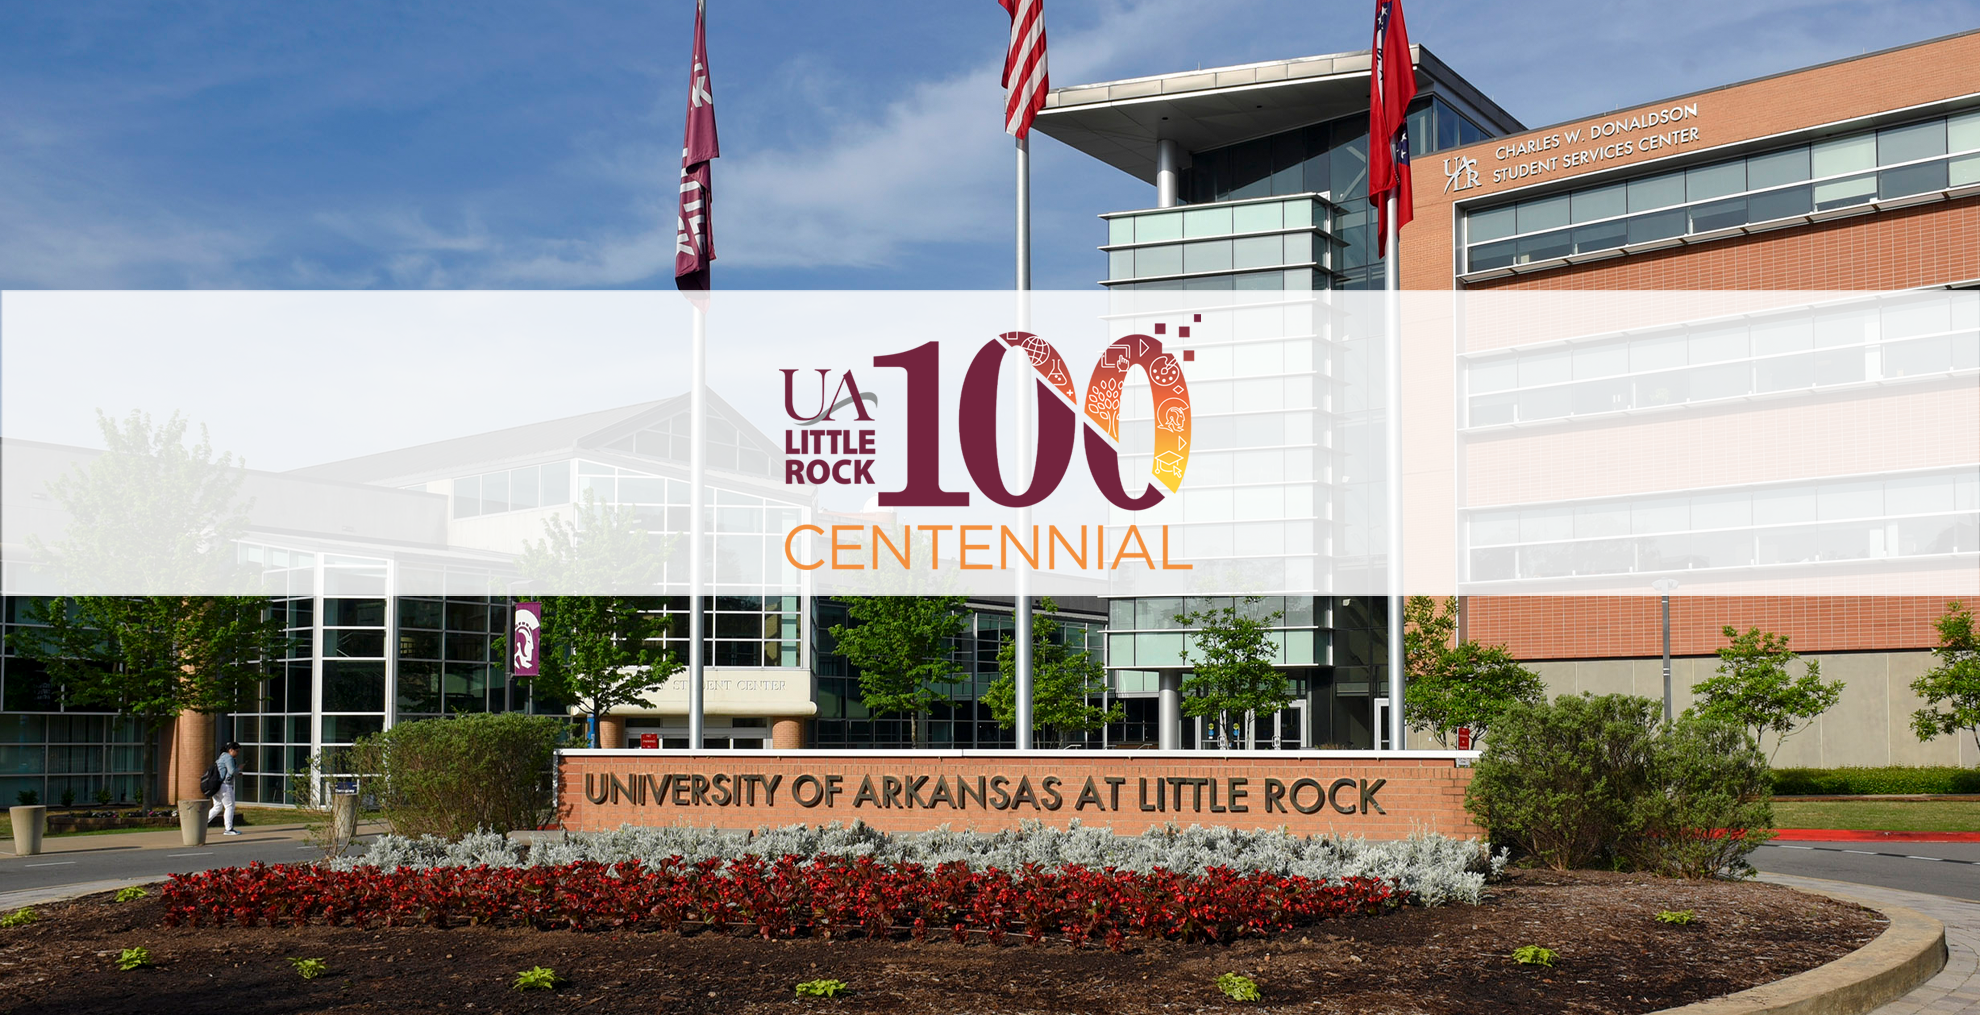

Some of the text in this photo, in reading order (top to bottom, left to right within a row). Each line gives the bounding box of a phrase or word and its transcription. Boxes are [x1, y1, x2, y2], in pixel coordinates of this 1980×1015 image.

[1493, 127, 1700, 183] STUDENT SERVICES CENTER
[1495, 103, 1698, 160] CHARLES W. DONALDSON
[673, 680, 732, 691] STENT
[737, 680, 786, 691] CENTER
[585, 772, 1387, 815] UNIVERSITY OF ARKANSAS AT LITTLE ROCK
